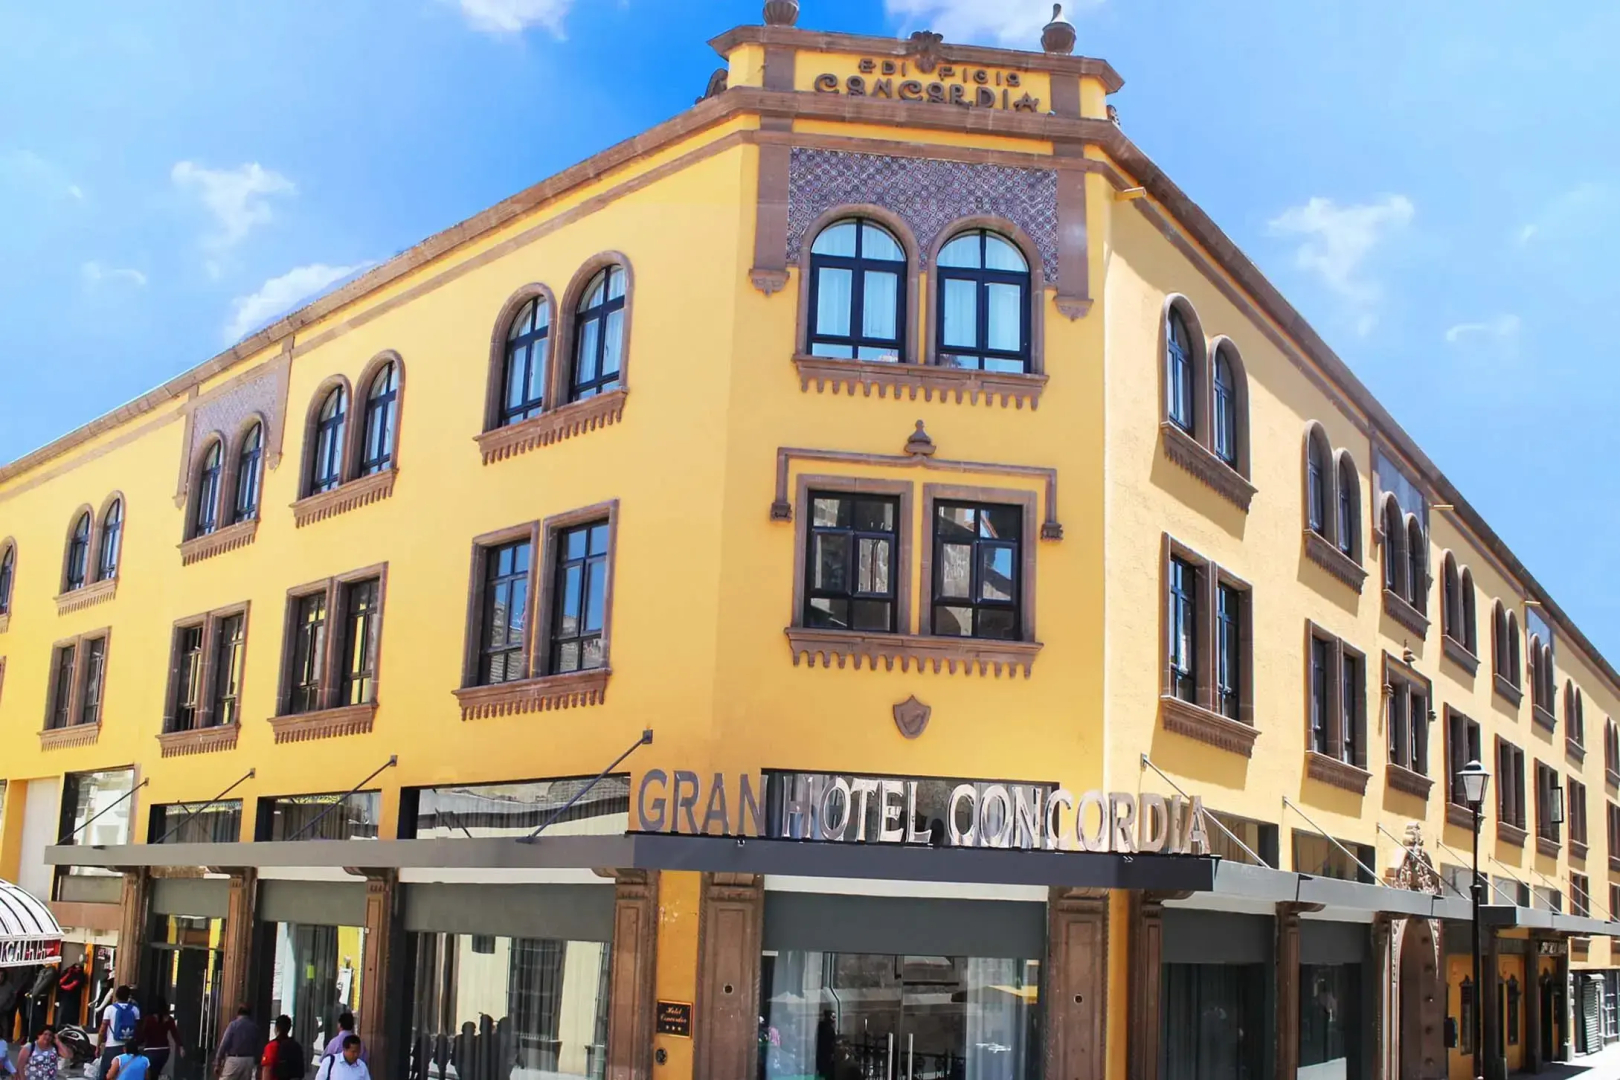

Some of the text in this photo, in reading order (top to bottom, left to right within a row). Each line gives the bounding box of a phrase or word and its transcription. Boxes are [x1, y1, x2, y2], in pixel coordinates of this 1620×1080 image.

[858, 58, 1021, 87] EDIFICIO
[814, 73, 1040, 113] CONCORDIA
[638, 769, 1211, 855] GRAN HOTEL CONCORDIA
